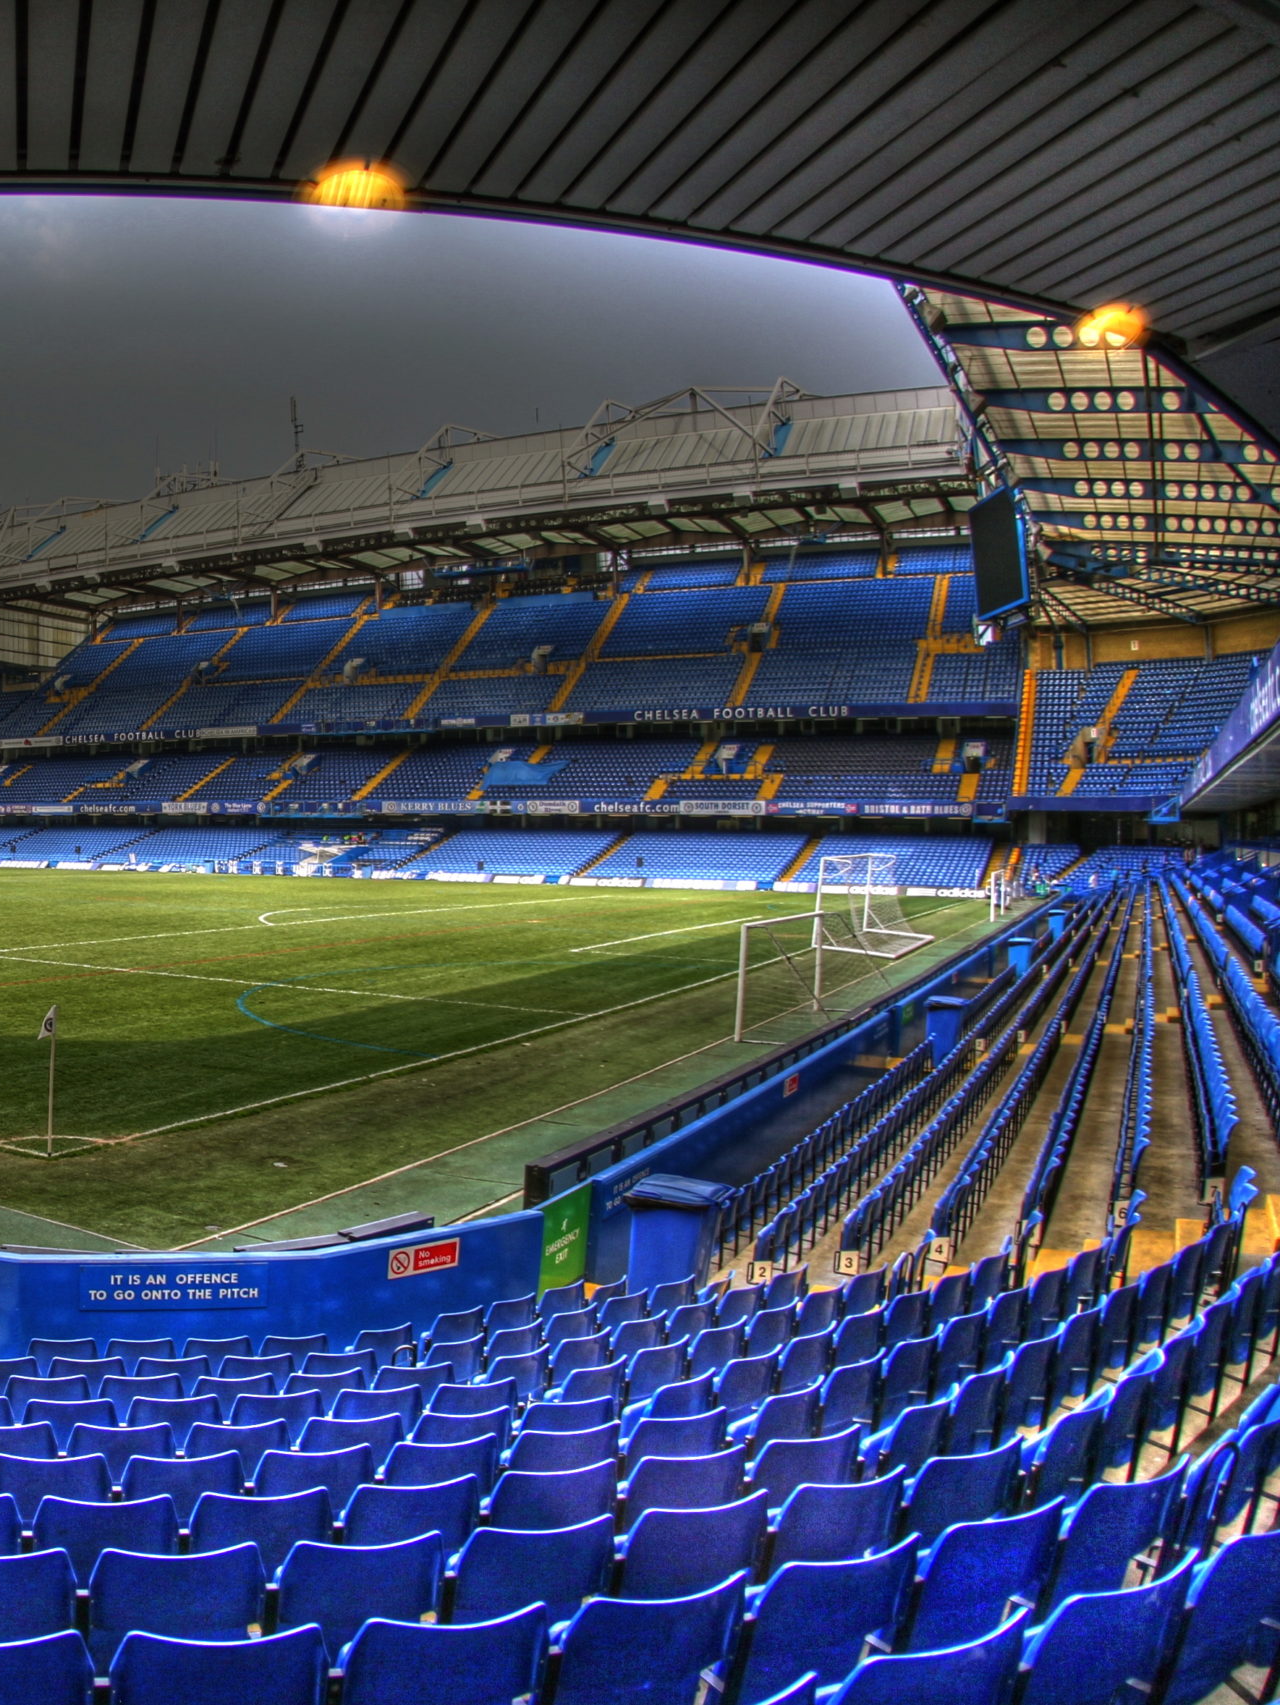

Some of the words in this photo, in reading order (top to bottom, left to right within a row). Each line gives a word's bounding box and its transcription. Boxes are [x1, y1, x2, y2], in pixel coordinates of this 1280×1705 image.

[634, 710, 700, 721] CHELSEA
[713, 707, 794, 720] FOOTBALL
[808, 705, 849, 718] CLUB
[65, 734, 106, 745] CHELSEA
[114, 731, 166, 742] FOOTBALL
[175, 729, 201, 739] CLUB
[80, 803, 136, 814] chelseafc.com
[400, 802, 436, 811] KERRY
[438, 802, 472, 811] BLUES
[594, 801, 680, 813] chelseafc.com
[694, 802, 719, 810] SOUTH
[721, 802, 750, 811] DORSET
[864, 804, 900, 814] BRISTOL
[910, 804, 931, 814] BATH
[934, 805, 959, 814] BLUES
[597, 877, 643, 888] adidas
[937, 887, 986, 898] adidas
[1118, 1207, 1128, 1219] 6
[545, 1227, 580, 1256] EMERGENCY
[418, 1250, 431, 1259] No
[934, 1243, 943, 1254] 4
[418, 1254, 452, 1267] smoking
[555, 1247, 569, 1264] EXIT
[844, 1257, 853, 1268] 3
[110, 1274, 123, 1285] IT
[128, 1274, 141, 1285] IS
[146, 1274, 166, 1285] AN
[175, 1271, 239, 1285] OFFENCE
[758, 1266, 766, 1278] 2
[89, 1290, 107, 1301] TO
[114, 1290, 135, 1301] GO
[141, 1289, 182, 1301] ONTO
[187, 1289, 213, 1300] THE
[219, 1287, 259, 1300] PITCH
